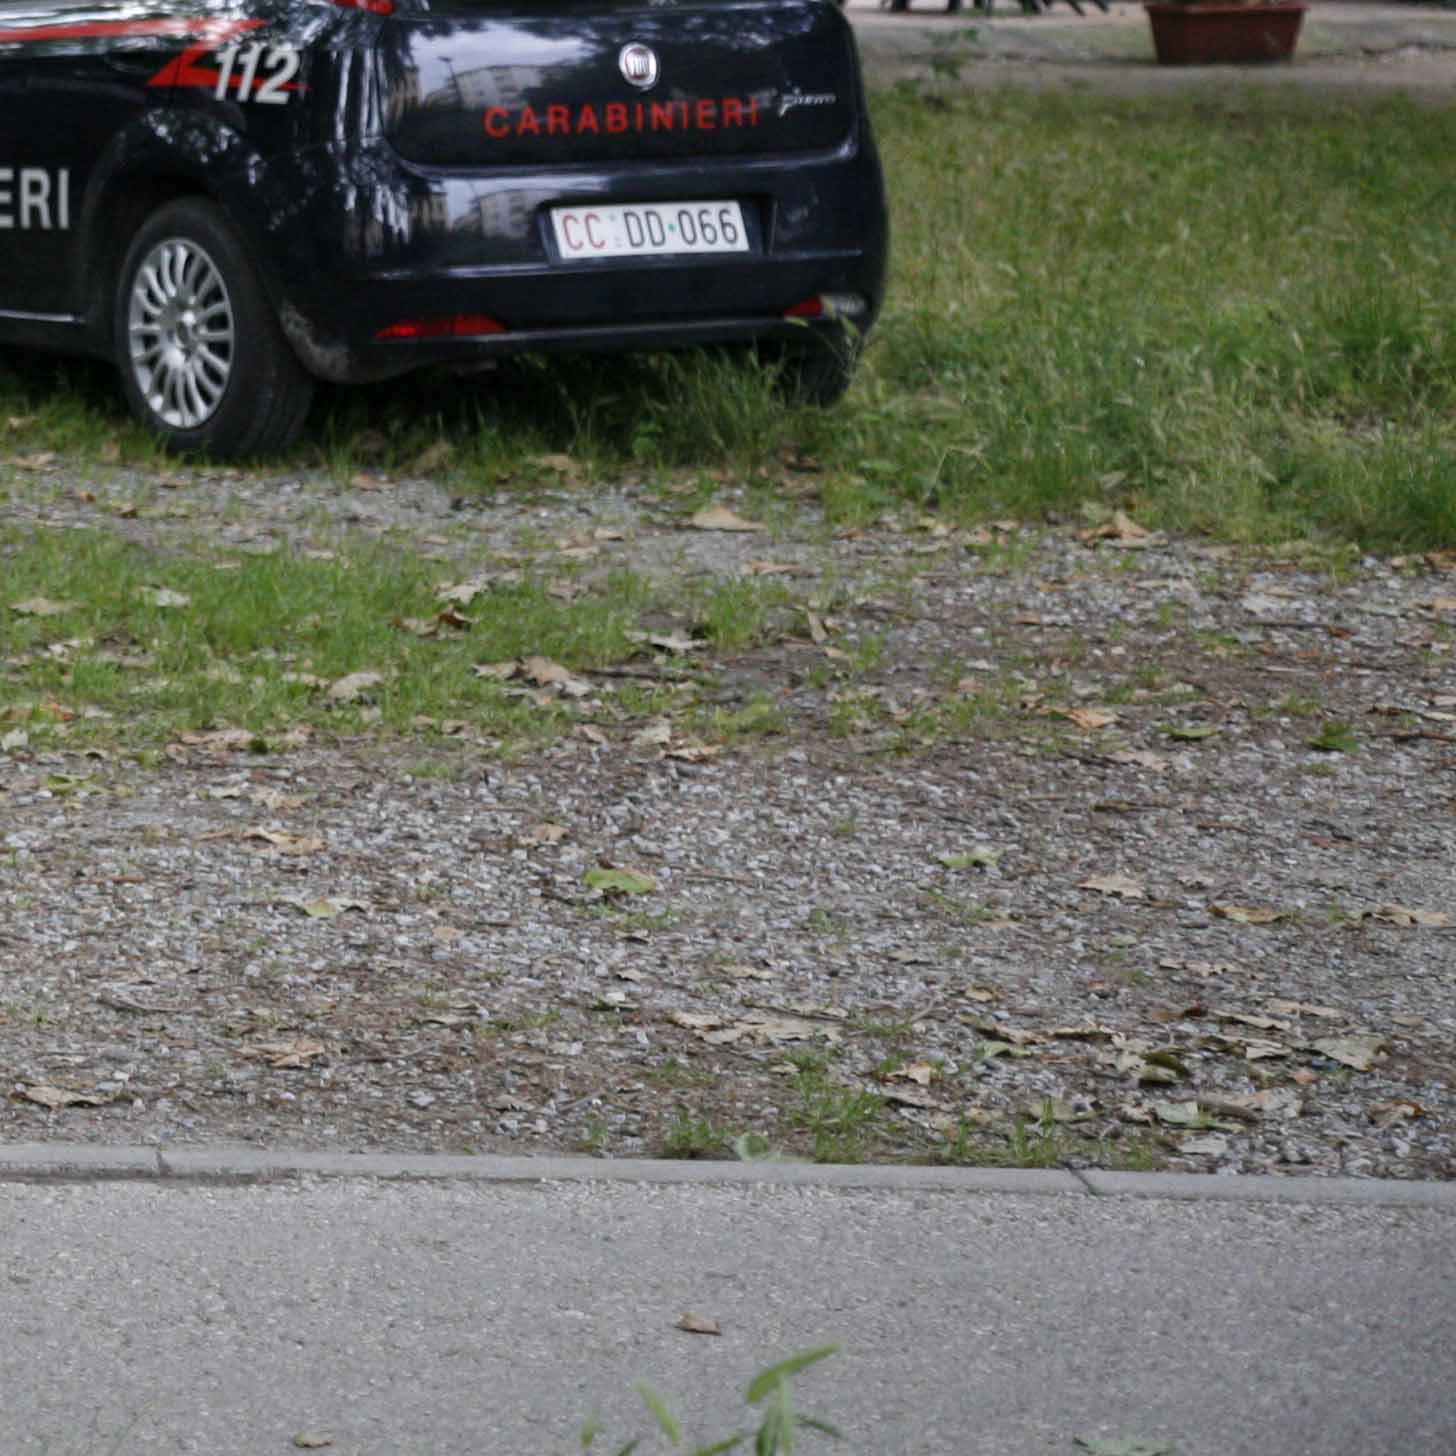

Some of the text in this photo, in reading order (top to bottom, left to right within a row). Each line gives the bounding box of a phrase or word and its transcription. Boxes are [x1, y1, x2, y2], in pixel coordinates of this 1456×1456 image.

[215, 40, 300, 105] 112
[483, 96, 760, 138] CARABINIERI
[561, 208, 739, 251] CC DD 066
